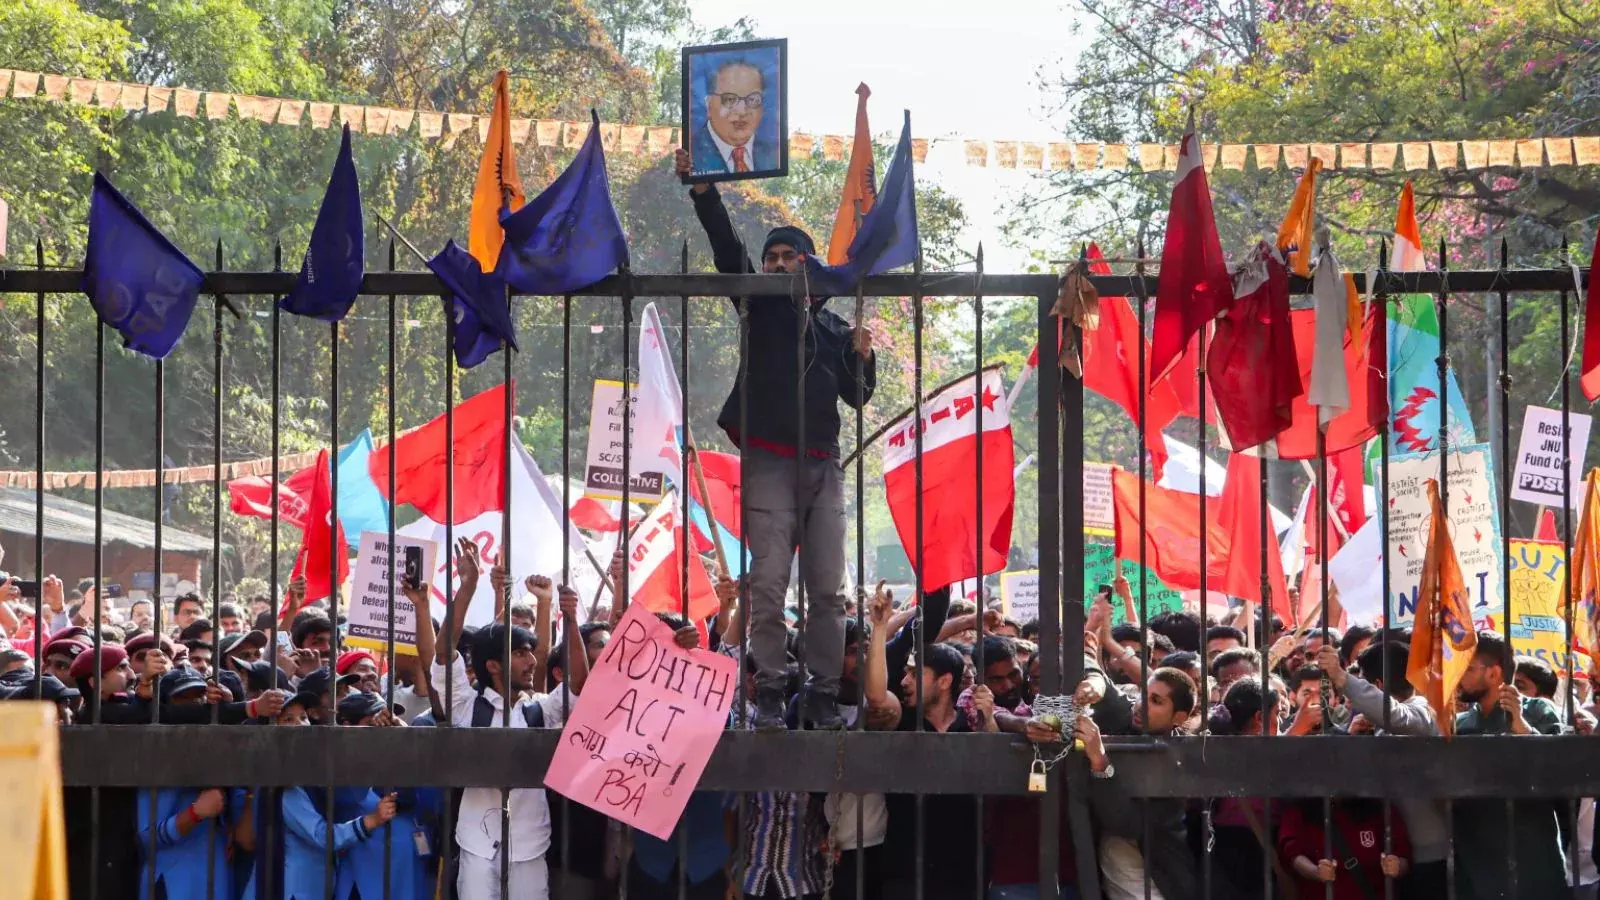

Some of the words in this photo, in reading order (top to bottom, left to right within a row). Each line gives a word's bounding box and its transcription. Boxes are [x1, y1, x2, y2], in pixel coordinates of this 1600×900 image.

[609, 422, 621, 433] Fill
[1540, 439, 1562, 453] JNU
[1524, 453, 1551, 468] Fund
[604, 618, 730, 712] ROHITH
[604, 688, 685, 743] ACT
